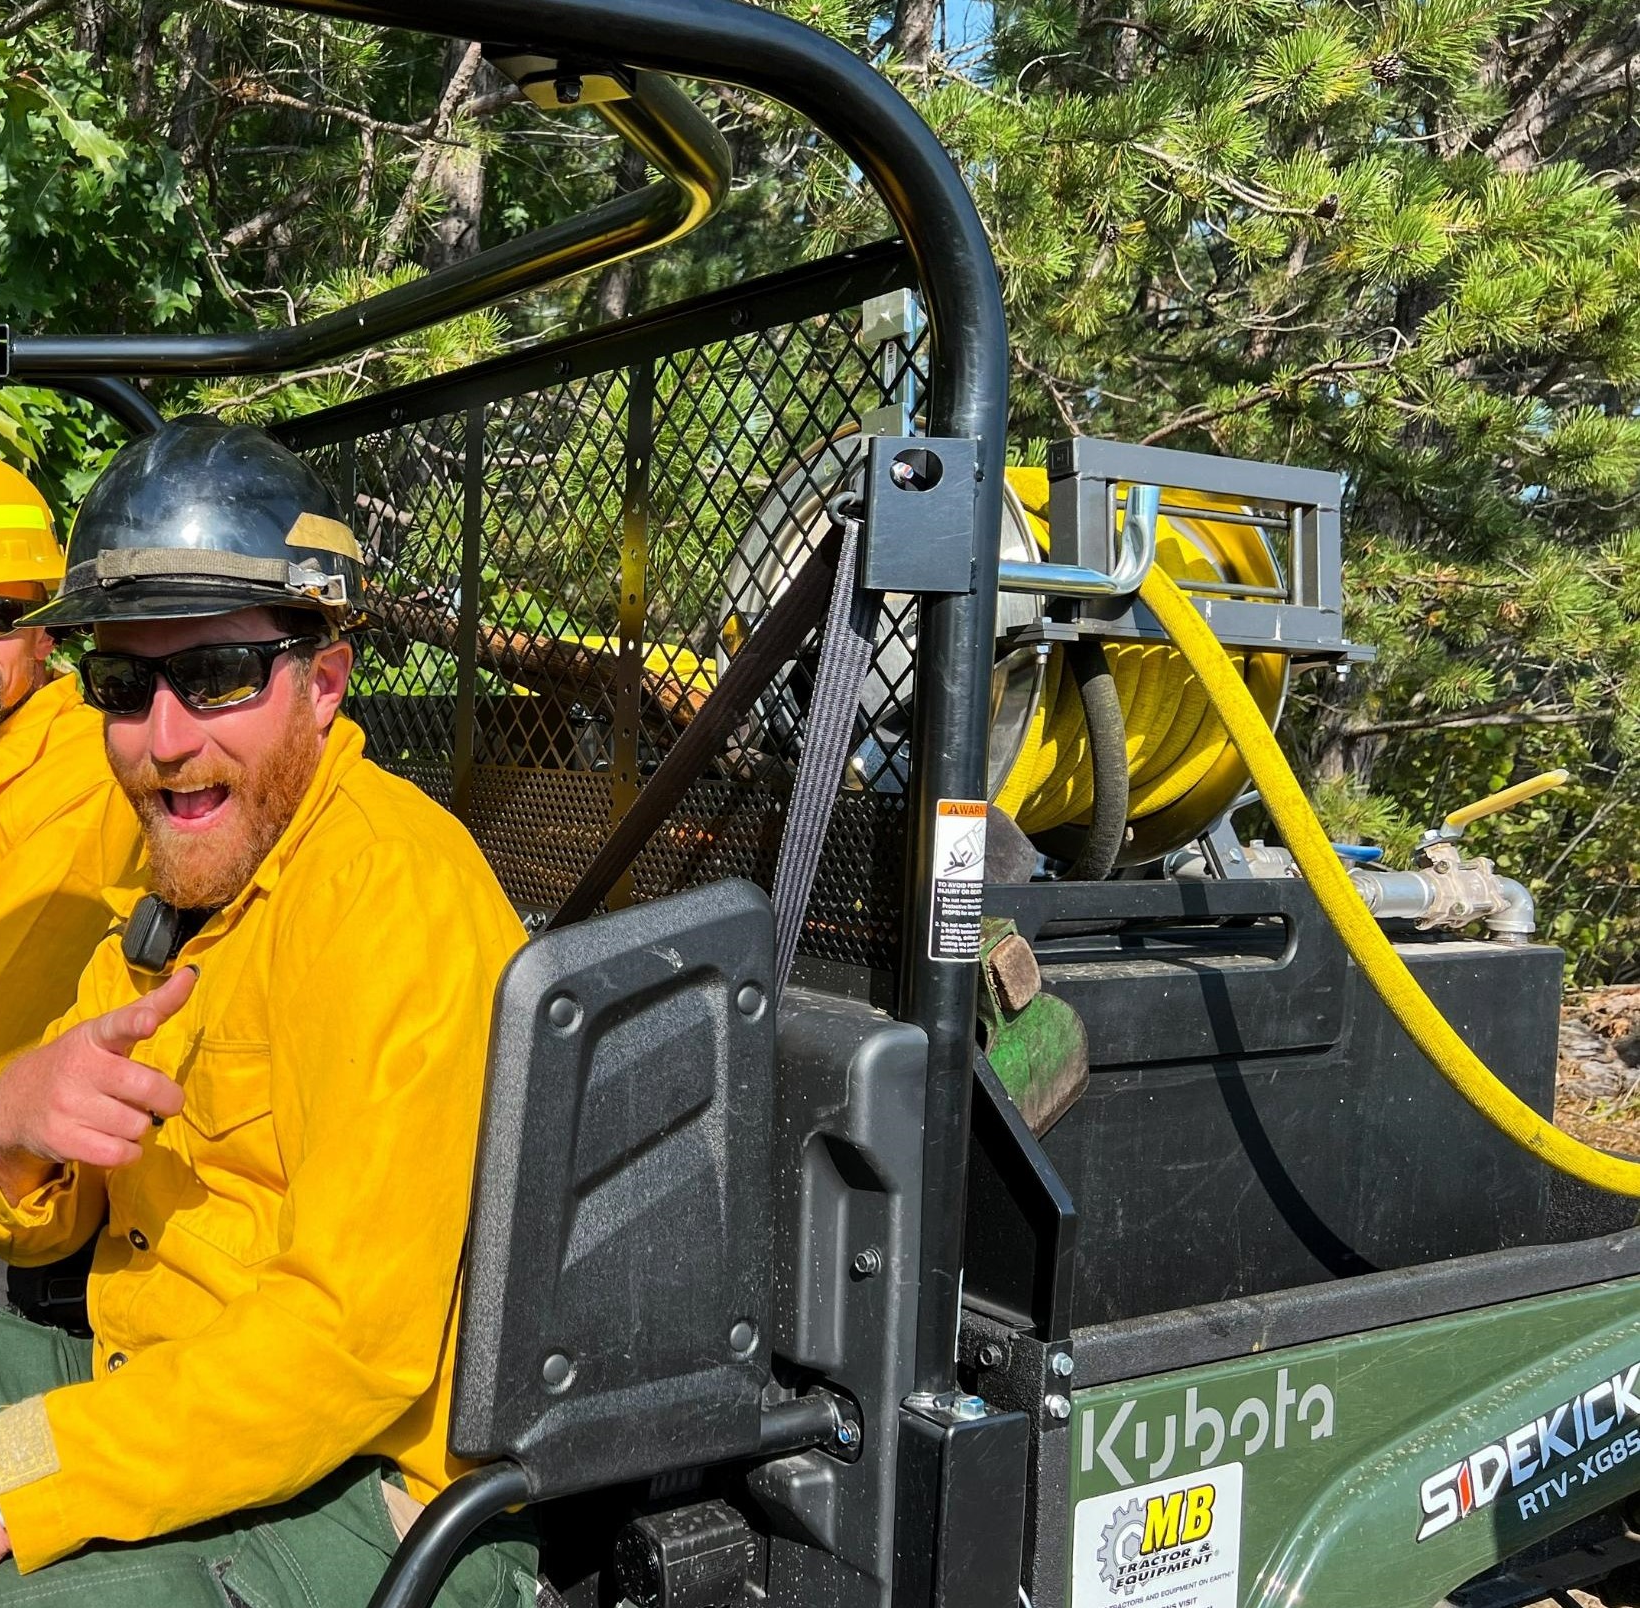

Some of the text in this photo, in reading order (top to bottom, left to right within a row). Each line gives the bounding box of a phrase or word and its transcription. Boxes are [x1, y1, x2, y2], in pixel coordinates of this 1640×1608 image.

[1081, 1368, 1334, 1486] Kubota
[1417, 1362, 1640, 1543] SIDEKICK
[1139, 1483, 1216, 1556] MB
[1115, 1553, 1212, 1587] EQUIPMENT
[1118, 1542, 1210, 1575] TRACTOR &
[1145, 1592, 1160, 1601] AND
[1161, 1581, 1197, 1597] EQUIPMENT
[1199, 1578, 1208, 1586] ON
[1179, 1597, 1198, 1608] VISIT
